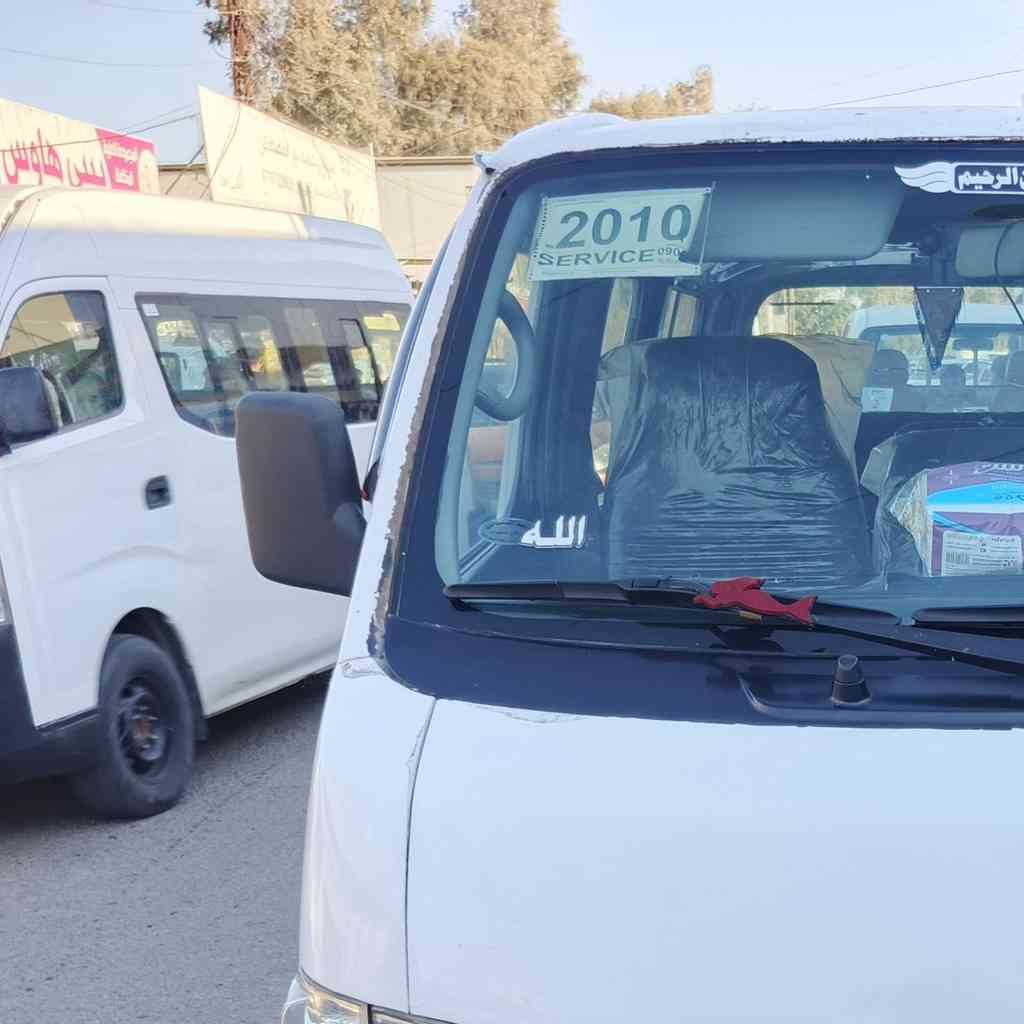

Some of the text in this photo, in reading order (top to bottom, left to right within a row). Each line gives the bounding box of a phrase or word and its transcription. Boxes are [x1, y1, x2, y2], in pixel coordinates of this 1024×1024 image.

[958, 166, 1018, 190] الرحيم
[556, 203, 692, 248] 2010
[537, 249, 655, 267] SERVICE
[521, 515, 586, 547] الله
